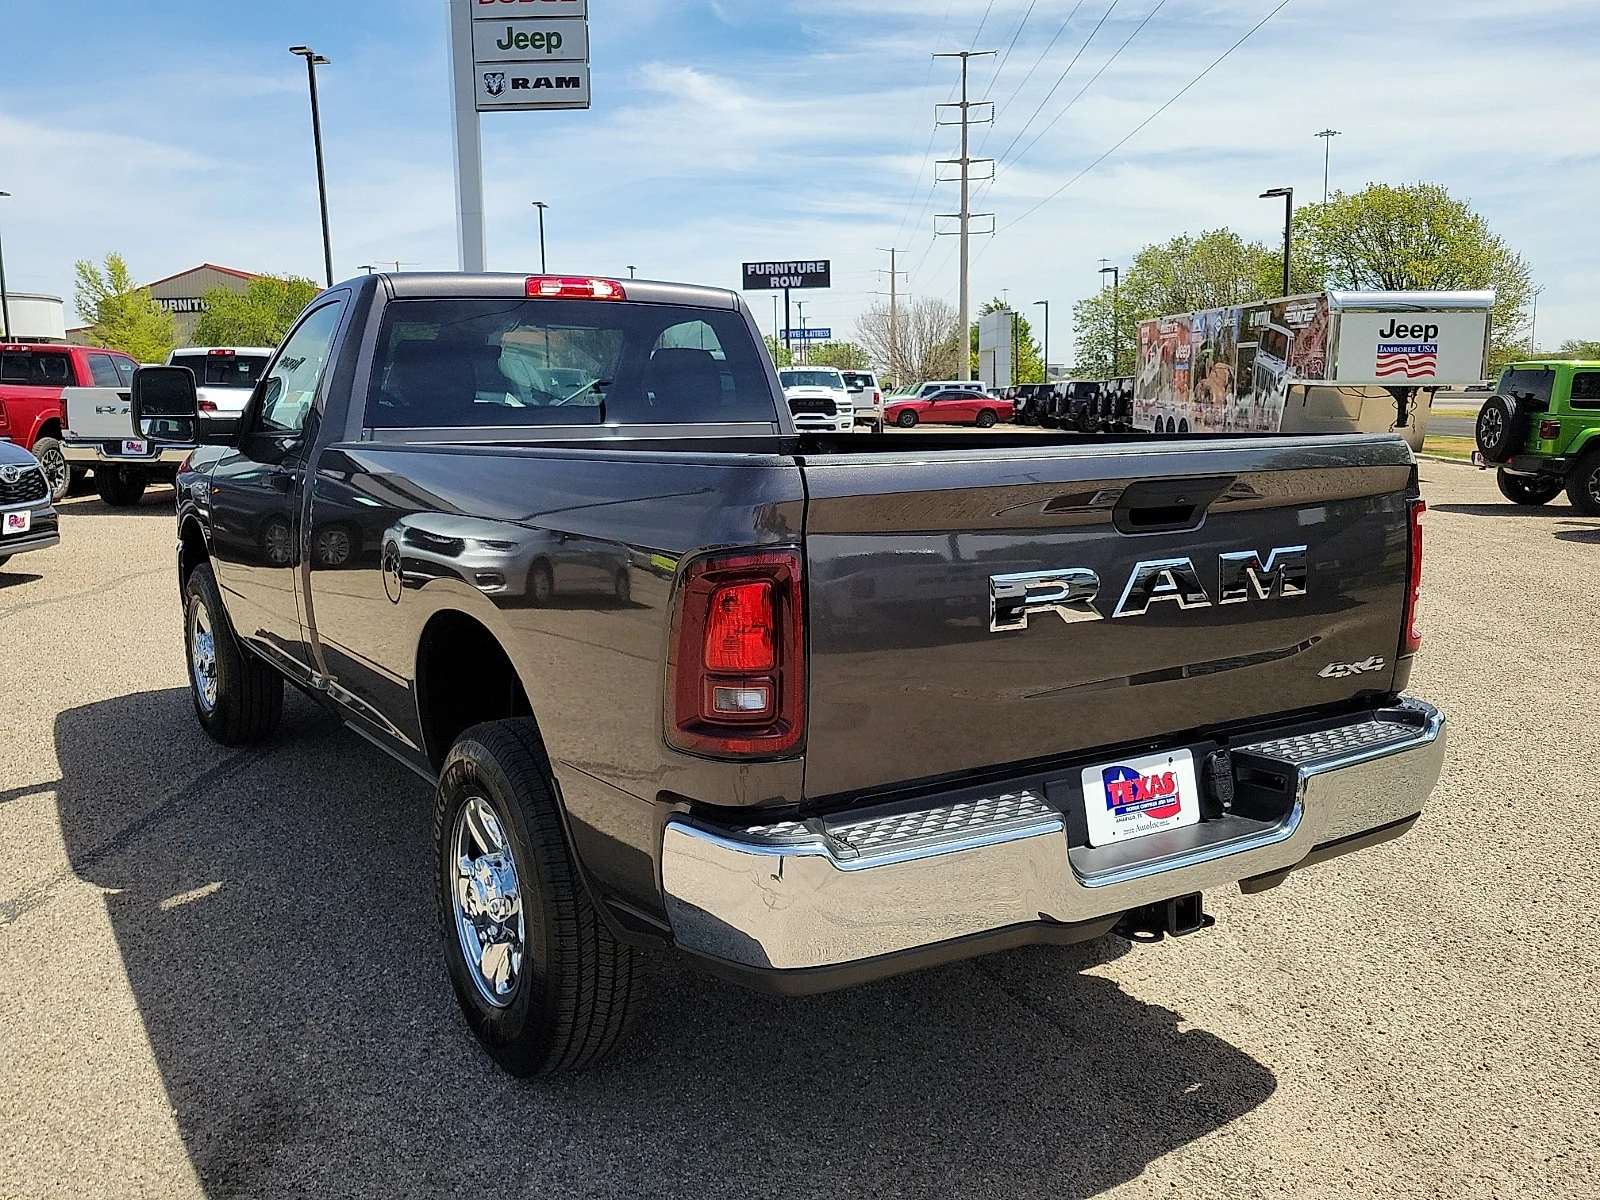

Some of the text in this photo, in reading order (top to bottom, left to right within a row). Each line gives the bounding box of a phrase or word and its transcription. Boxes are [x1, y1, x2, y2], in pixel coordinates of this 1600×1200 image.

[496, 26, 563, 54] Jeep
[511, 77, 580, 89] RAM
[747, 262, 826, 275] FURNITURE
[770, 276, 803, 288] ROW
[1379, 318, 1439, 343] Jeep
[1417, 345, 1436, 353] USA
[989, 544, 1308, 633] RAM
[1107, 771, 1176, 806] TEXAS
